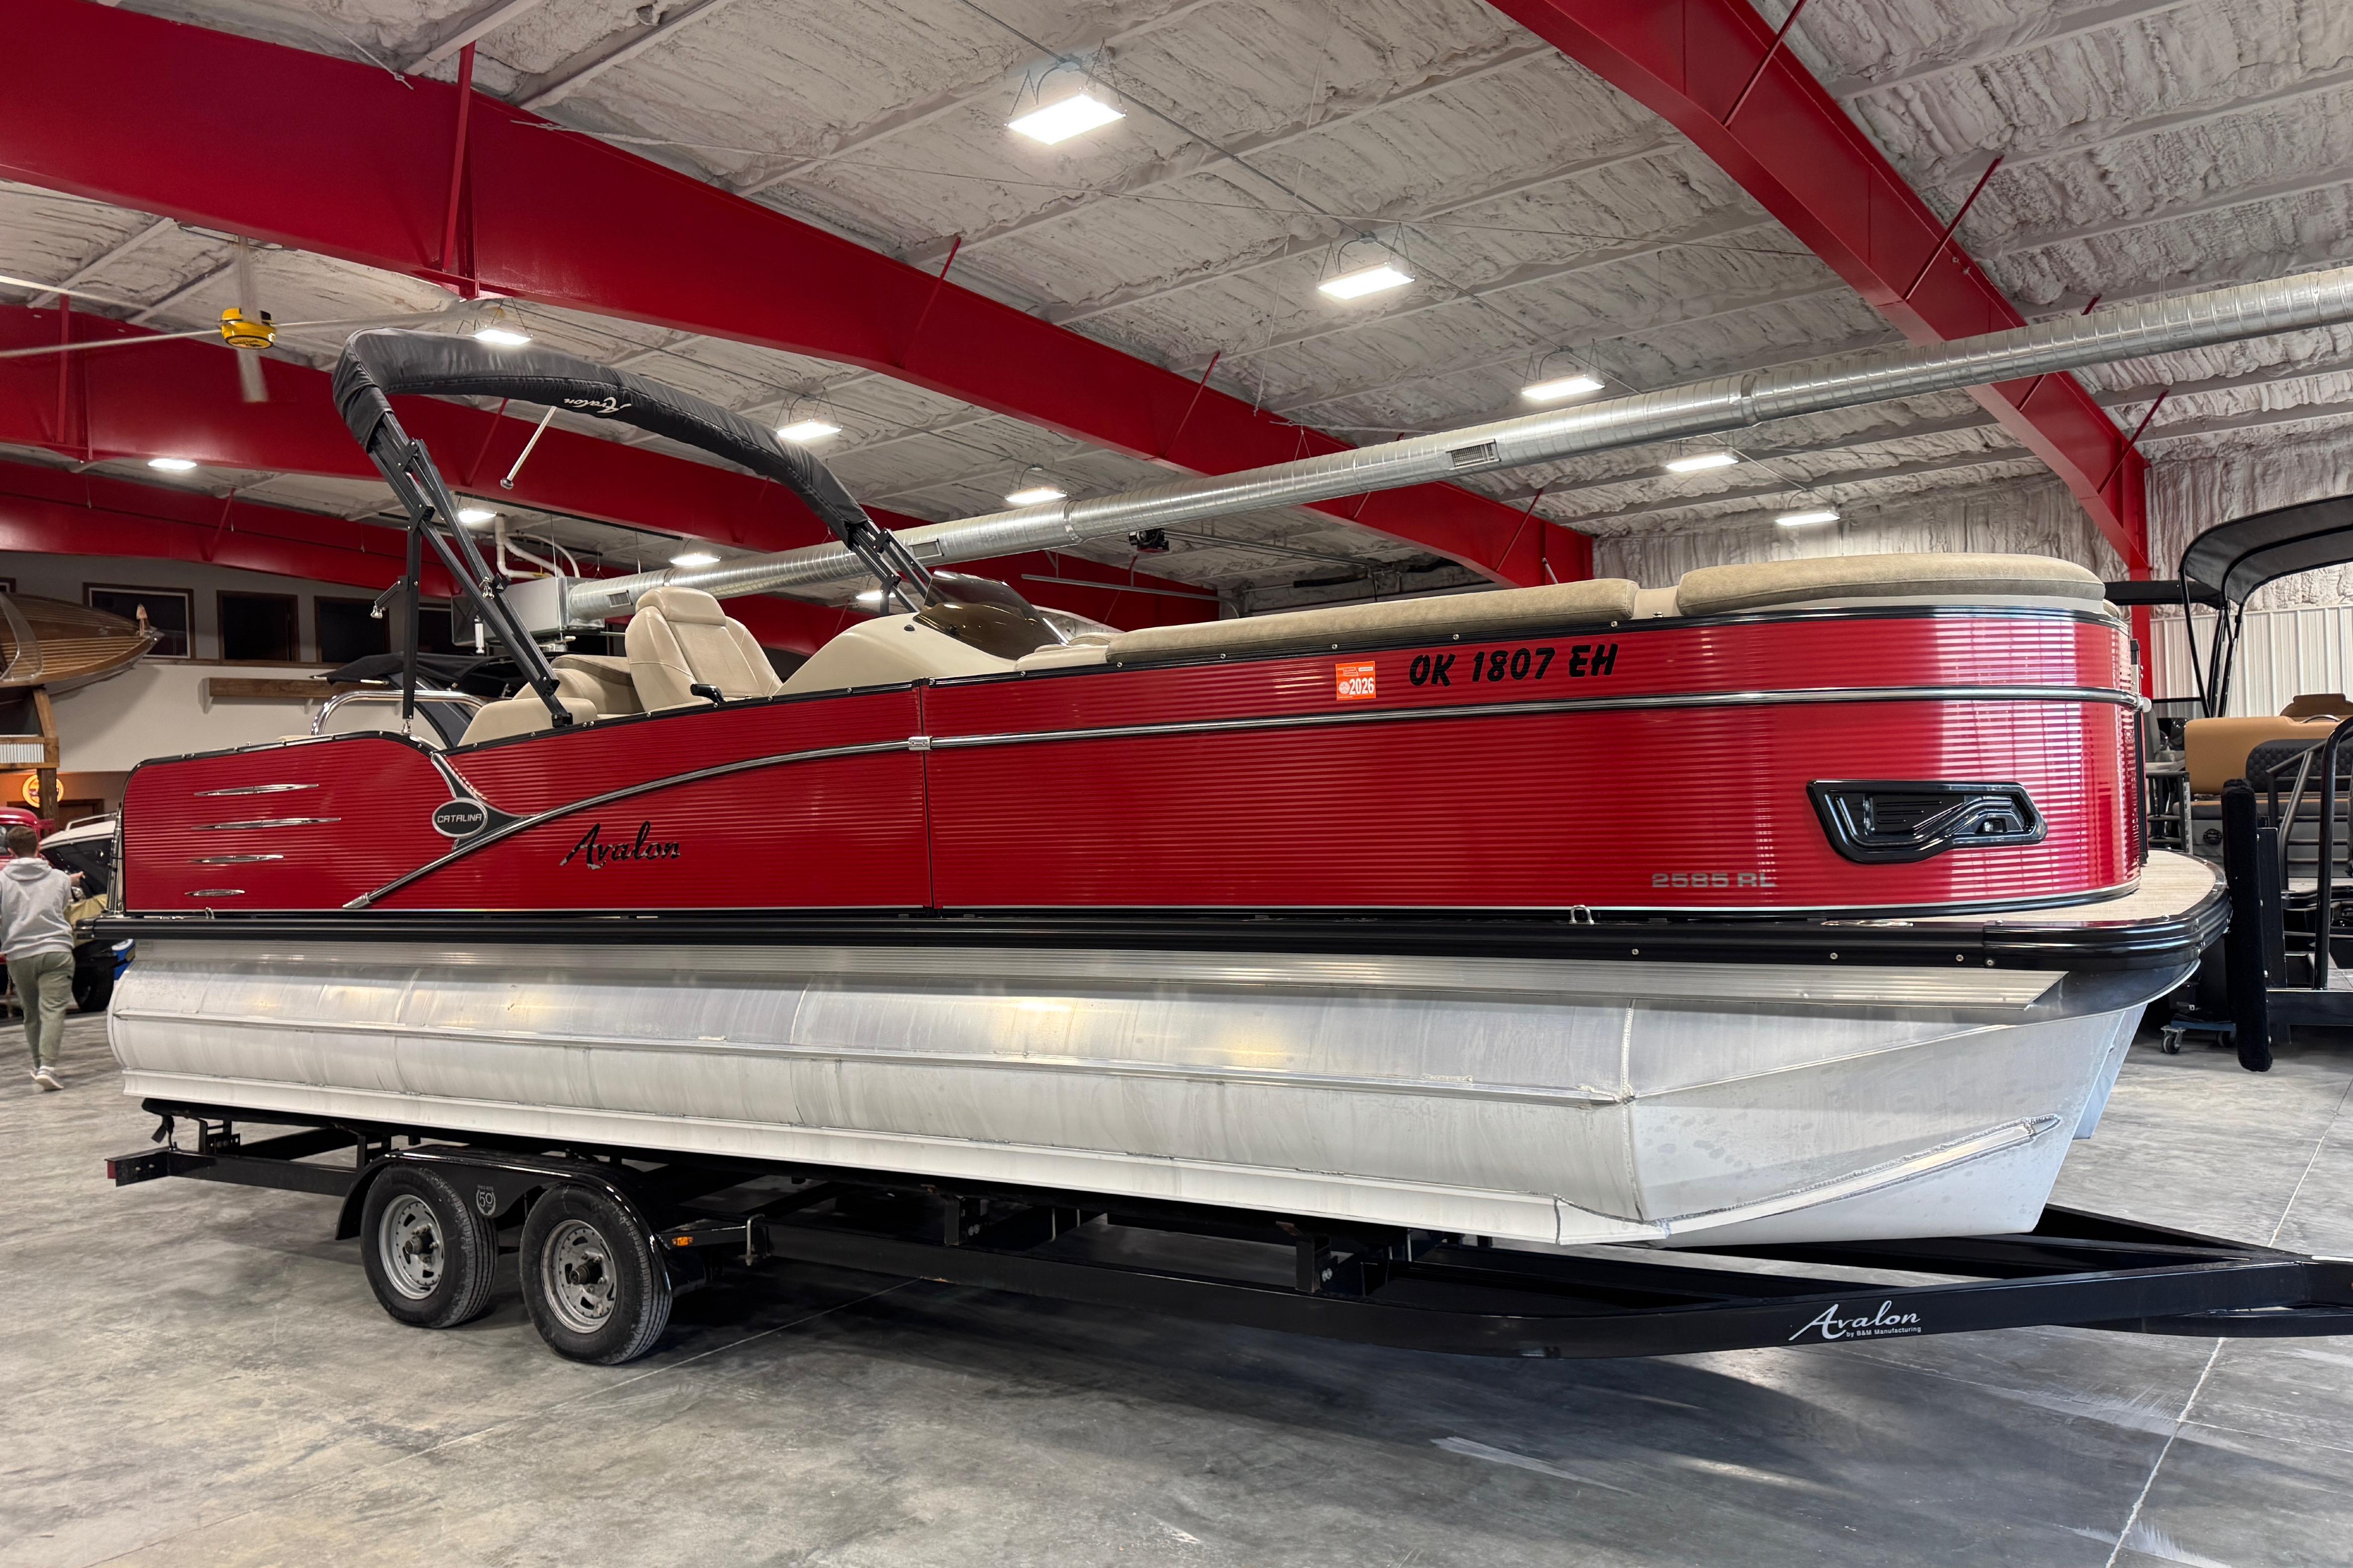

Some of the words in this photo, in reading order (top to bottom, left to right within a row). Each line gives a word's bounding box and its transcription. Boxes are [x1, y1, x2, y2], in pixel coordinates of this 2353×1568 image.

[564, 396, 631, 413] Avalon
[1410, 653, 1456, 686] OK
[1472, 648, 1555, 682] 1807
[1569, 643, 1619, 677] EH
[1349, 677, 1374, 695] 2026
[437, 813, 482, 823] CATALINA
[559, 821, 681, 870] Avalon
[1651, 874, 1729, 887] 2585
[1738, 873, 1777, 887] RL
[1788, 1300, 1921, 1339] Avalon
